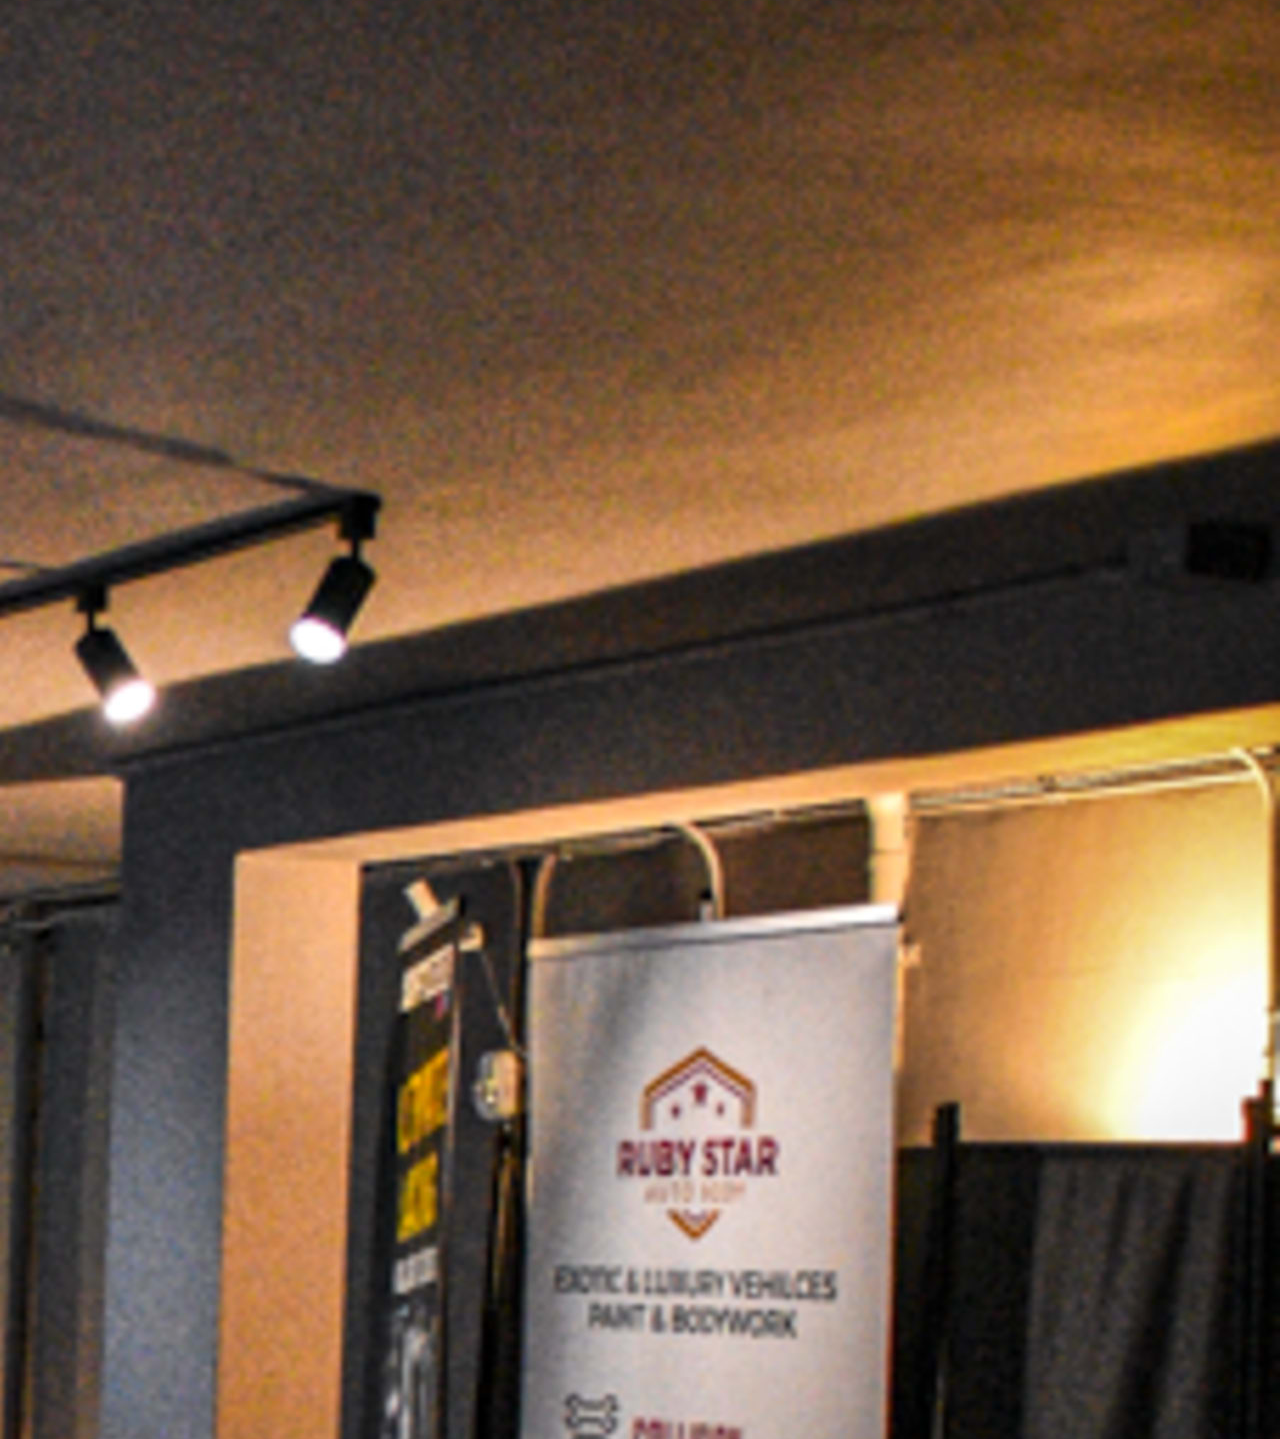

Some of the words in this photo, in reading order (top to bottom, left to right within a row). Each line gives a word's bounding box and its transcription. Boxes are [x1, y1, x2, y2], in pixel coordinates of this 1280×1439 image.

[616, 1140, 695, 1177] RUBY
[702, 1136, 779, 1176] STAR
[588, 1303, 645, 1330] PAINT
[672, 1304, 798, 1339] BODYWORK
